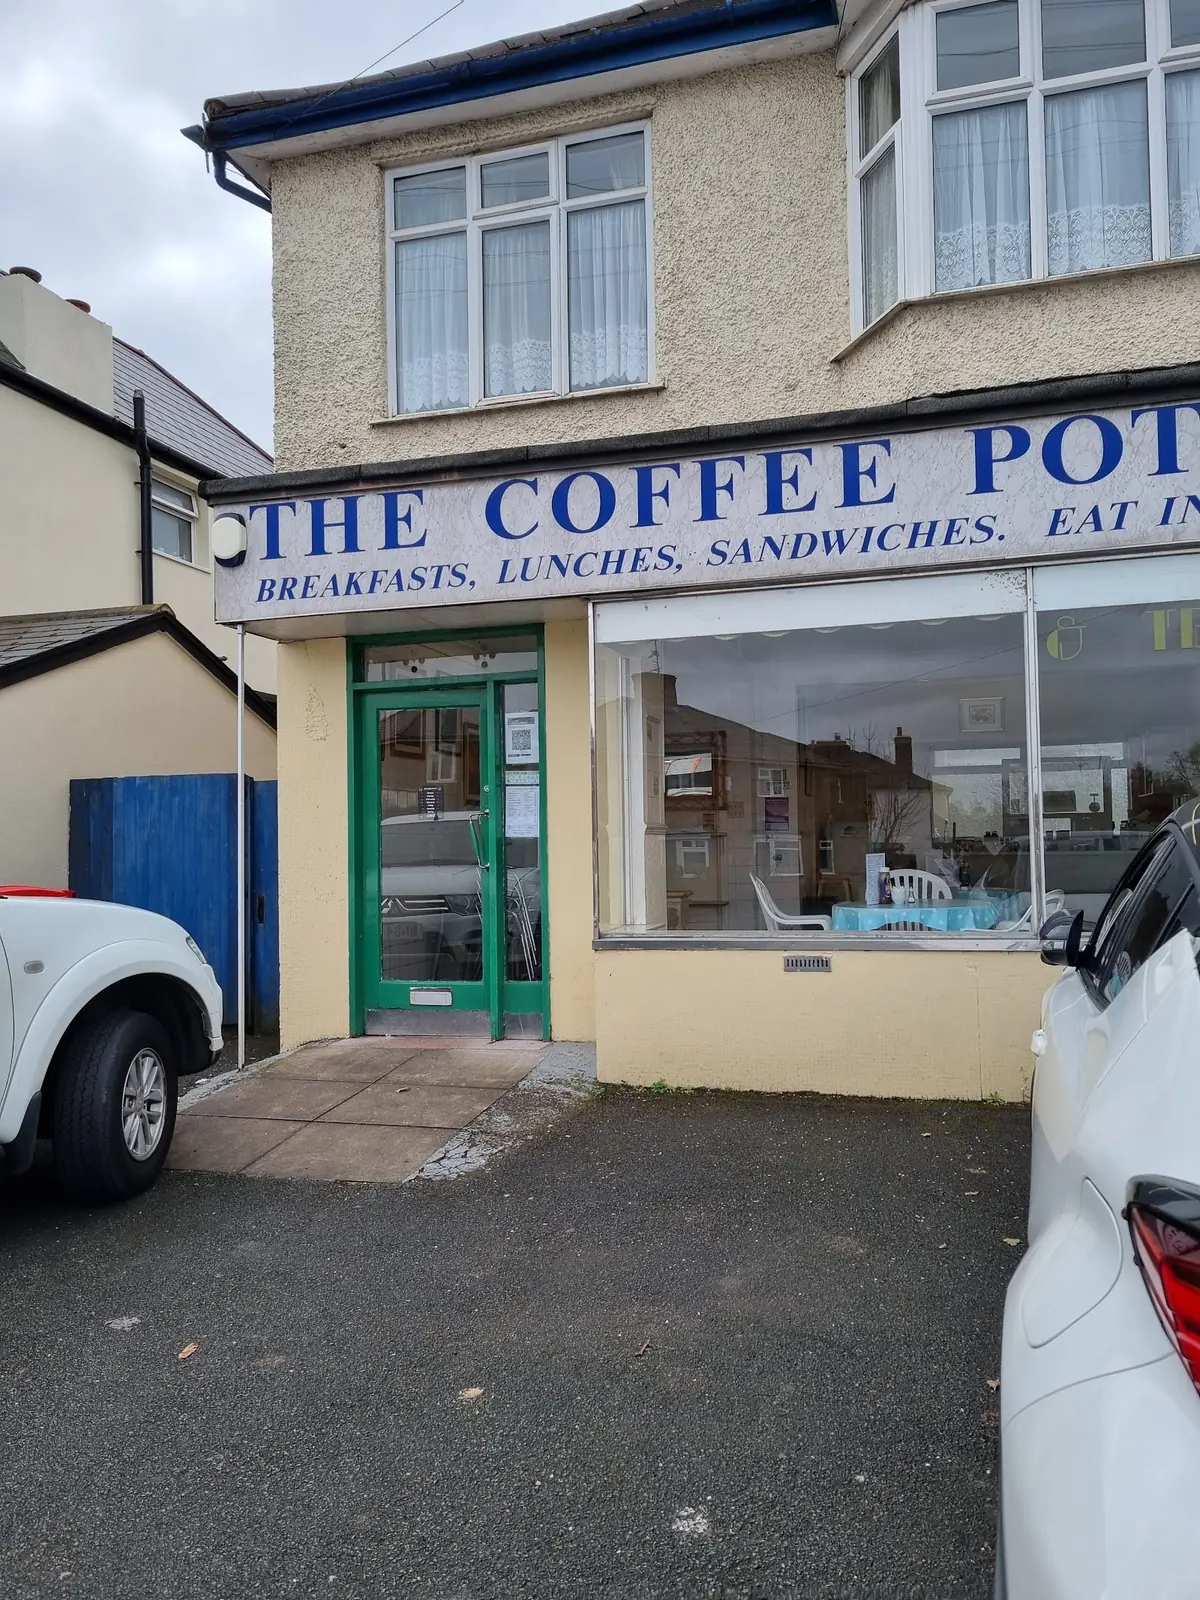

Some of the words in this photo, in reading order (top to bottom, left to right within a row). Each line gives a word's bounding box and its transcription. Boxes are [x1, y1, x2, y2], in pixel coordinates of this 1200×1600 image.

[248, 489, 428, 561] THE
[484, 437, 897, 541] COFFEE
[964, 402, 1200, 496] POT
[255, 562, 477, 603] BREAKFASTS,
[495, 544, 683, 584] LUNCHES,
[706, 514, 1005, 567] SANDWICHES.
[1044, 501, 1138, 537] EAT
